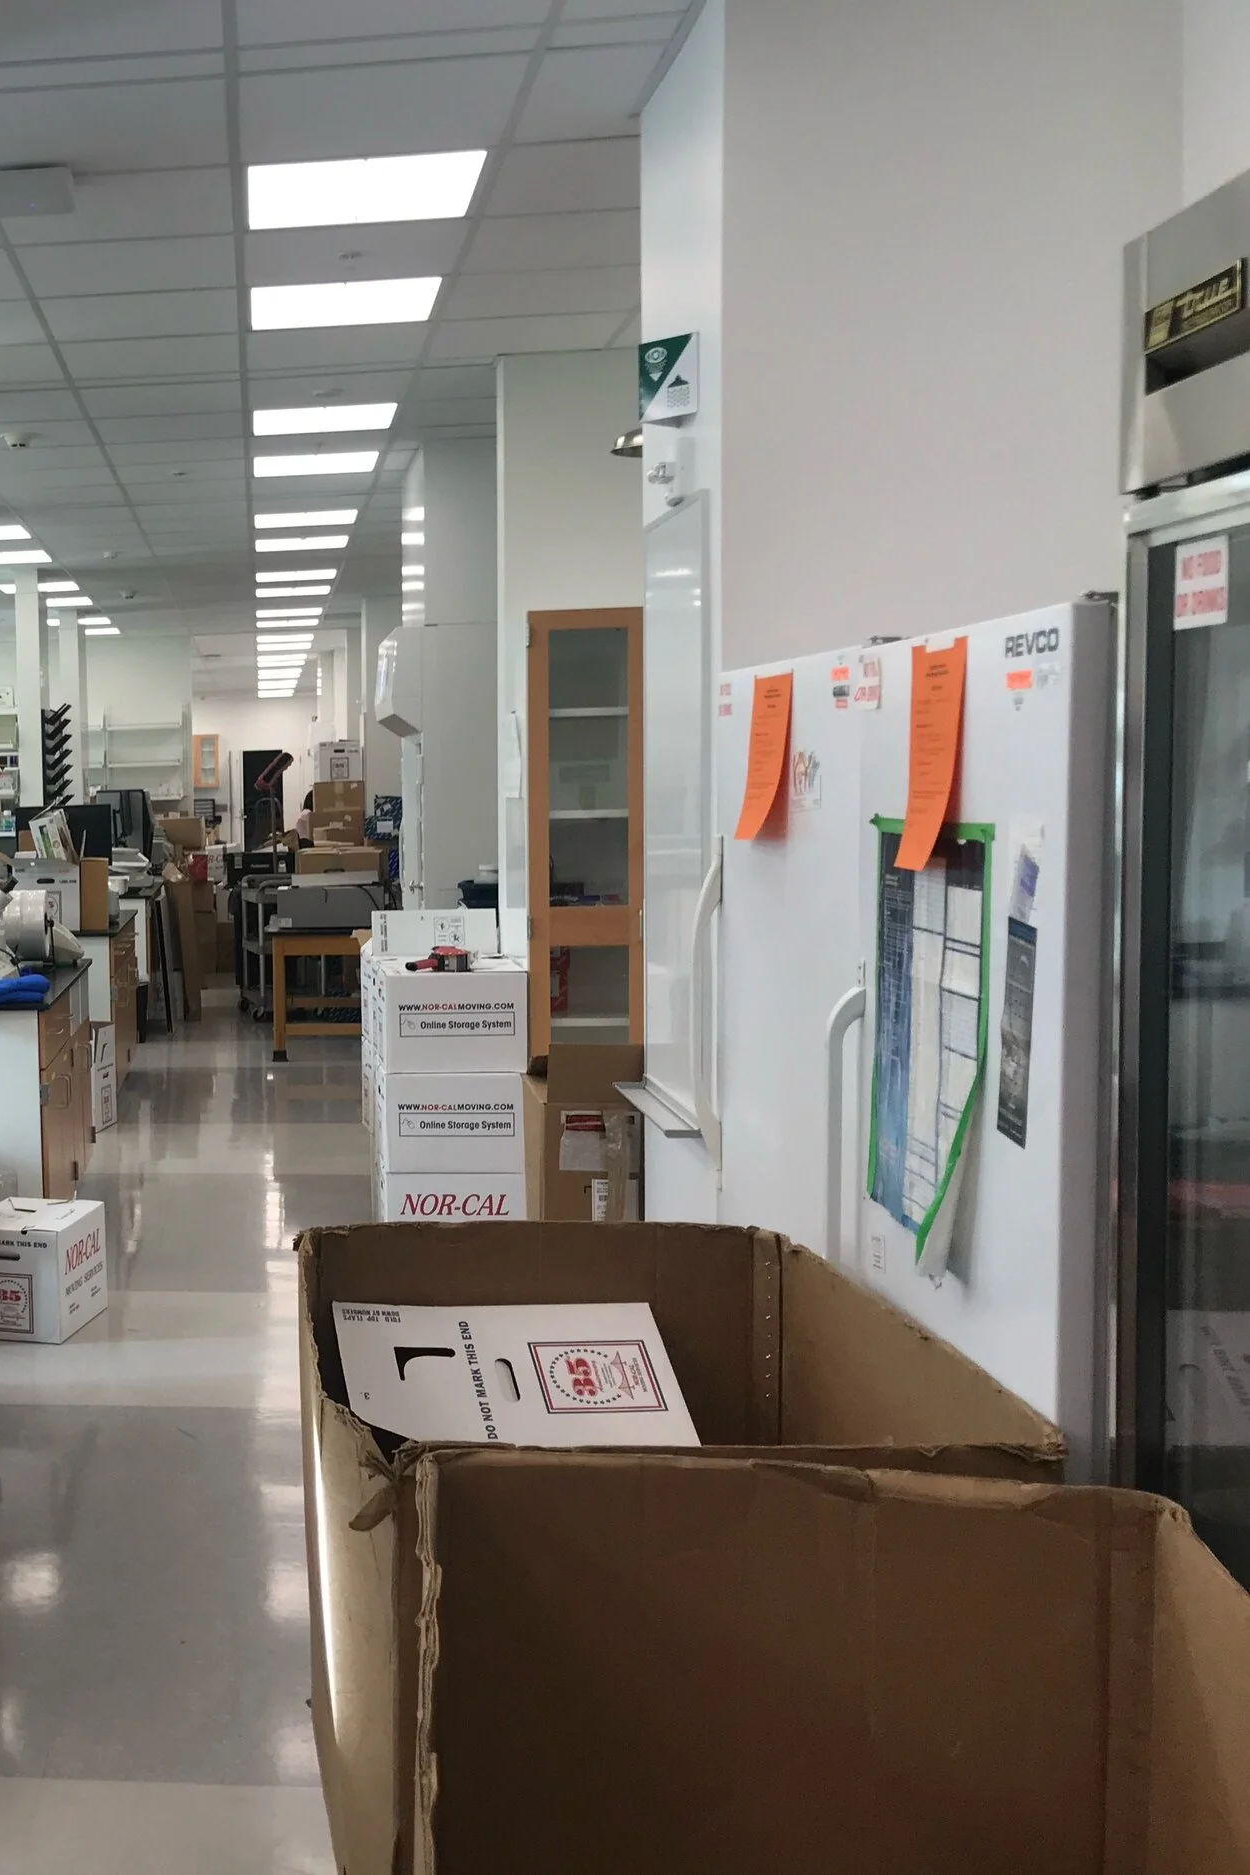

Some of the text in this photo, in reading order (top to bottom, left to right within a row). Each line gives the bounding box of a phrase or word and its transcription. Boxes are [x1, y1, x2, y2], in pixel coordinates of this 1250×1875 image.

[1004, 627, 1060, 659] REVCO
[398, 1002, 515, 1011] WWW.NOR-CALMOVING.COM
[420, 1019, 512, 1032] Online Storage System
[398, 1103, 514, 1111] WWW.NOR-CALMOVING.COM
[419, 1119, 512, 1132] Online Storage System
[401, 1193, 510, 1217] NOR-CAL
[65, 1228, 101, 1276] NOR-CAL
[458, 1320, 498, 1440] DO NOT MARK THIS END
[565, 1357, 598, 1397] 35
